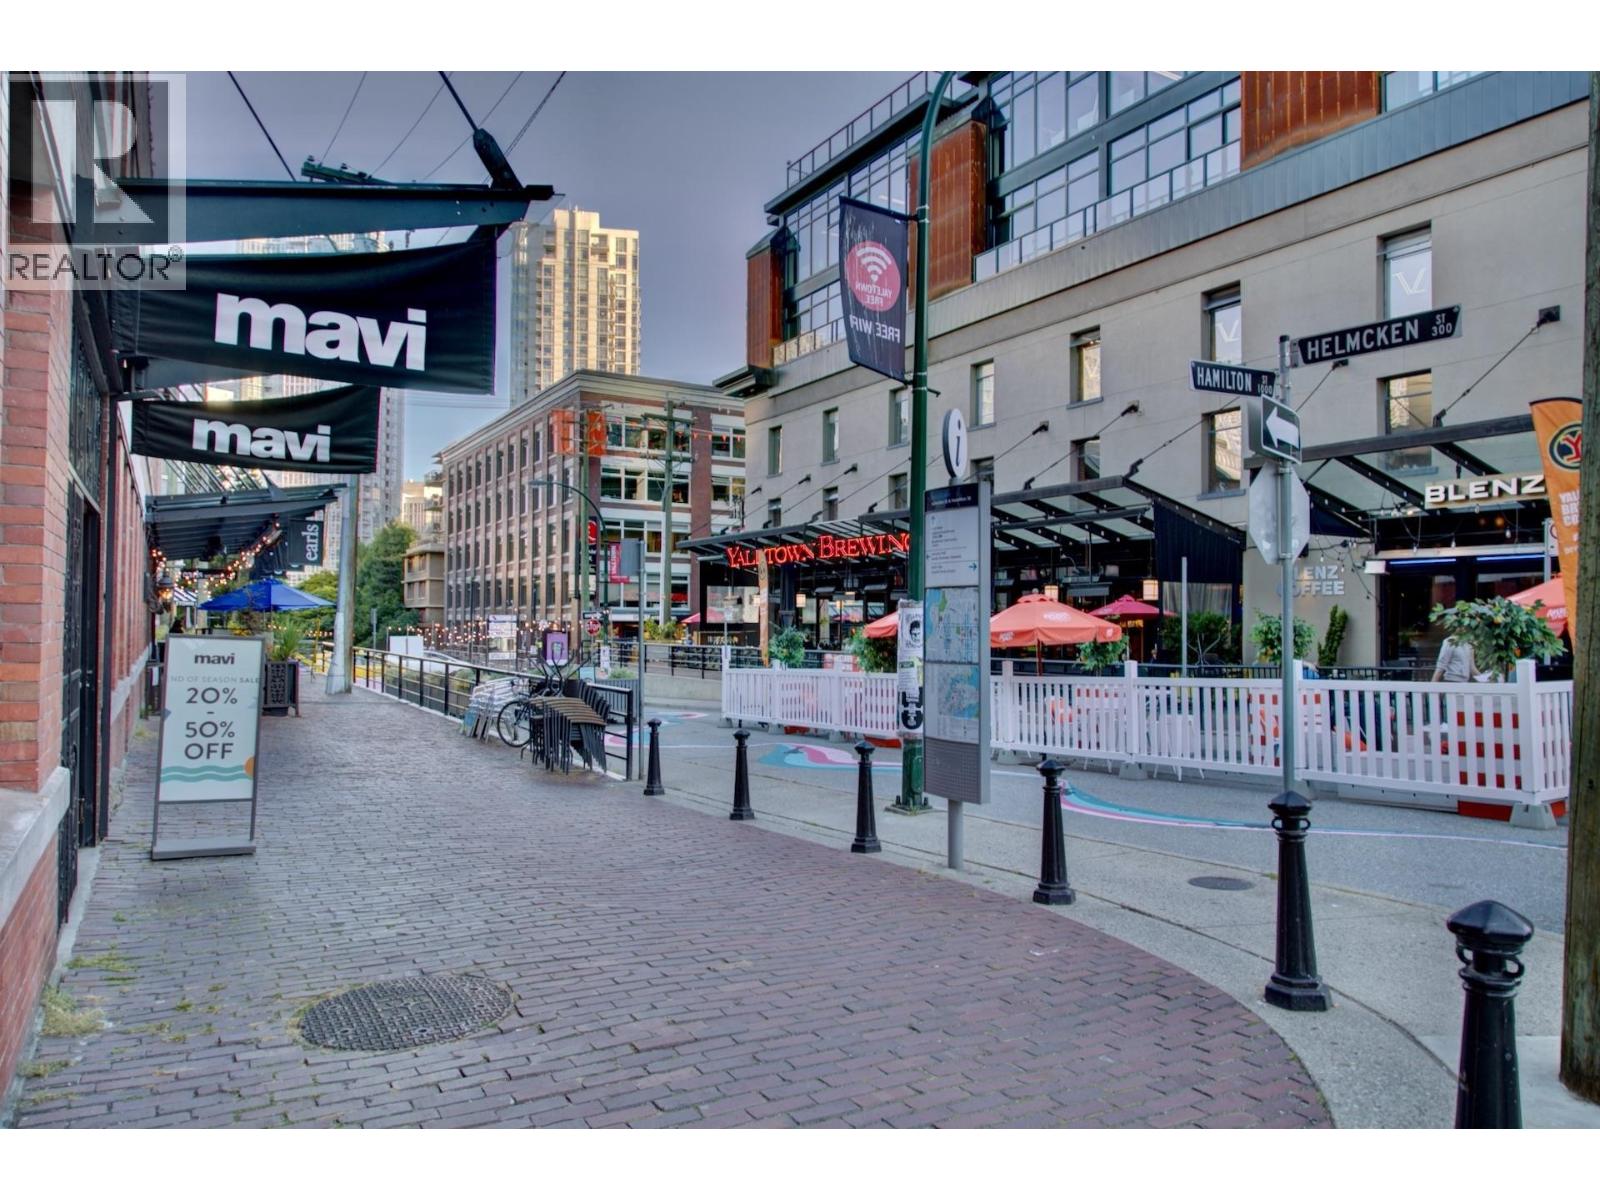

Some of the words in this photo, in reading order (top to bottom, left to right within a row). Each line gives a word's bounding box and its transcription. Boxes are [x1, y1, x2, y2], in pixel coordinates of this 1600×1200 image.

[215, 292, 427, 372] mavi
[1307, 319, 1419, 360] HELMCKEN
[1435, 313, 1446, 325] ST
[1431, 322, 1452, 337] 300
[1197, 366, 1252, 392] HAMILTON
[1262, 375, 1268, 384] ST
[1257, 383, 1273, 394] 1000
[192, 418, 331, 463] mavi
[1425, 474, 1545, 503] BLENZ
[301, 523, 320, 562] earls
[727, 544, 815, 568] YALTOWN
[194, 652, 236, 665] mavi
[186, 675, 198, 683] OF
[201, 676, 237, 684] SEASON
[186, 687, 238, 705] 20%
[185, 721, 236, 738] 50%
[184, 743, 234, 760] OFF
